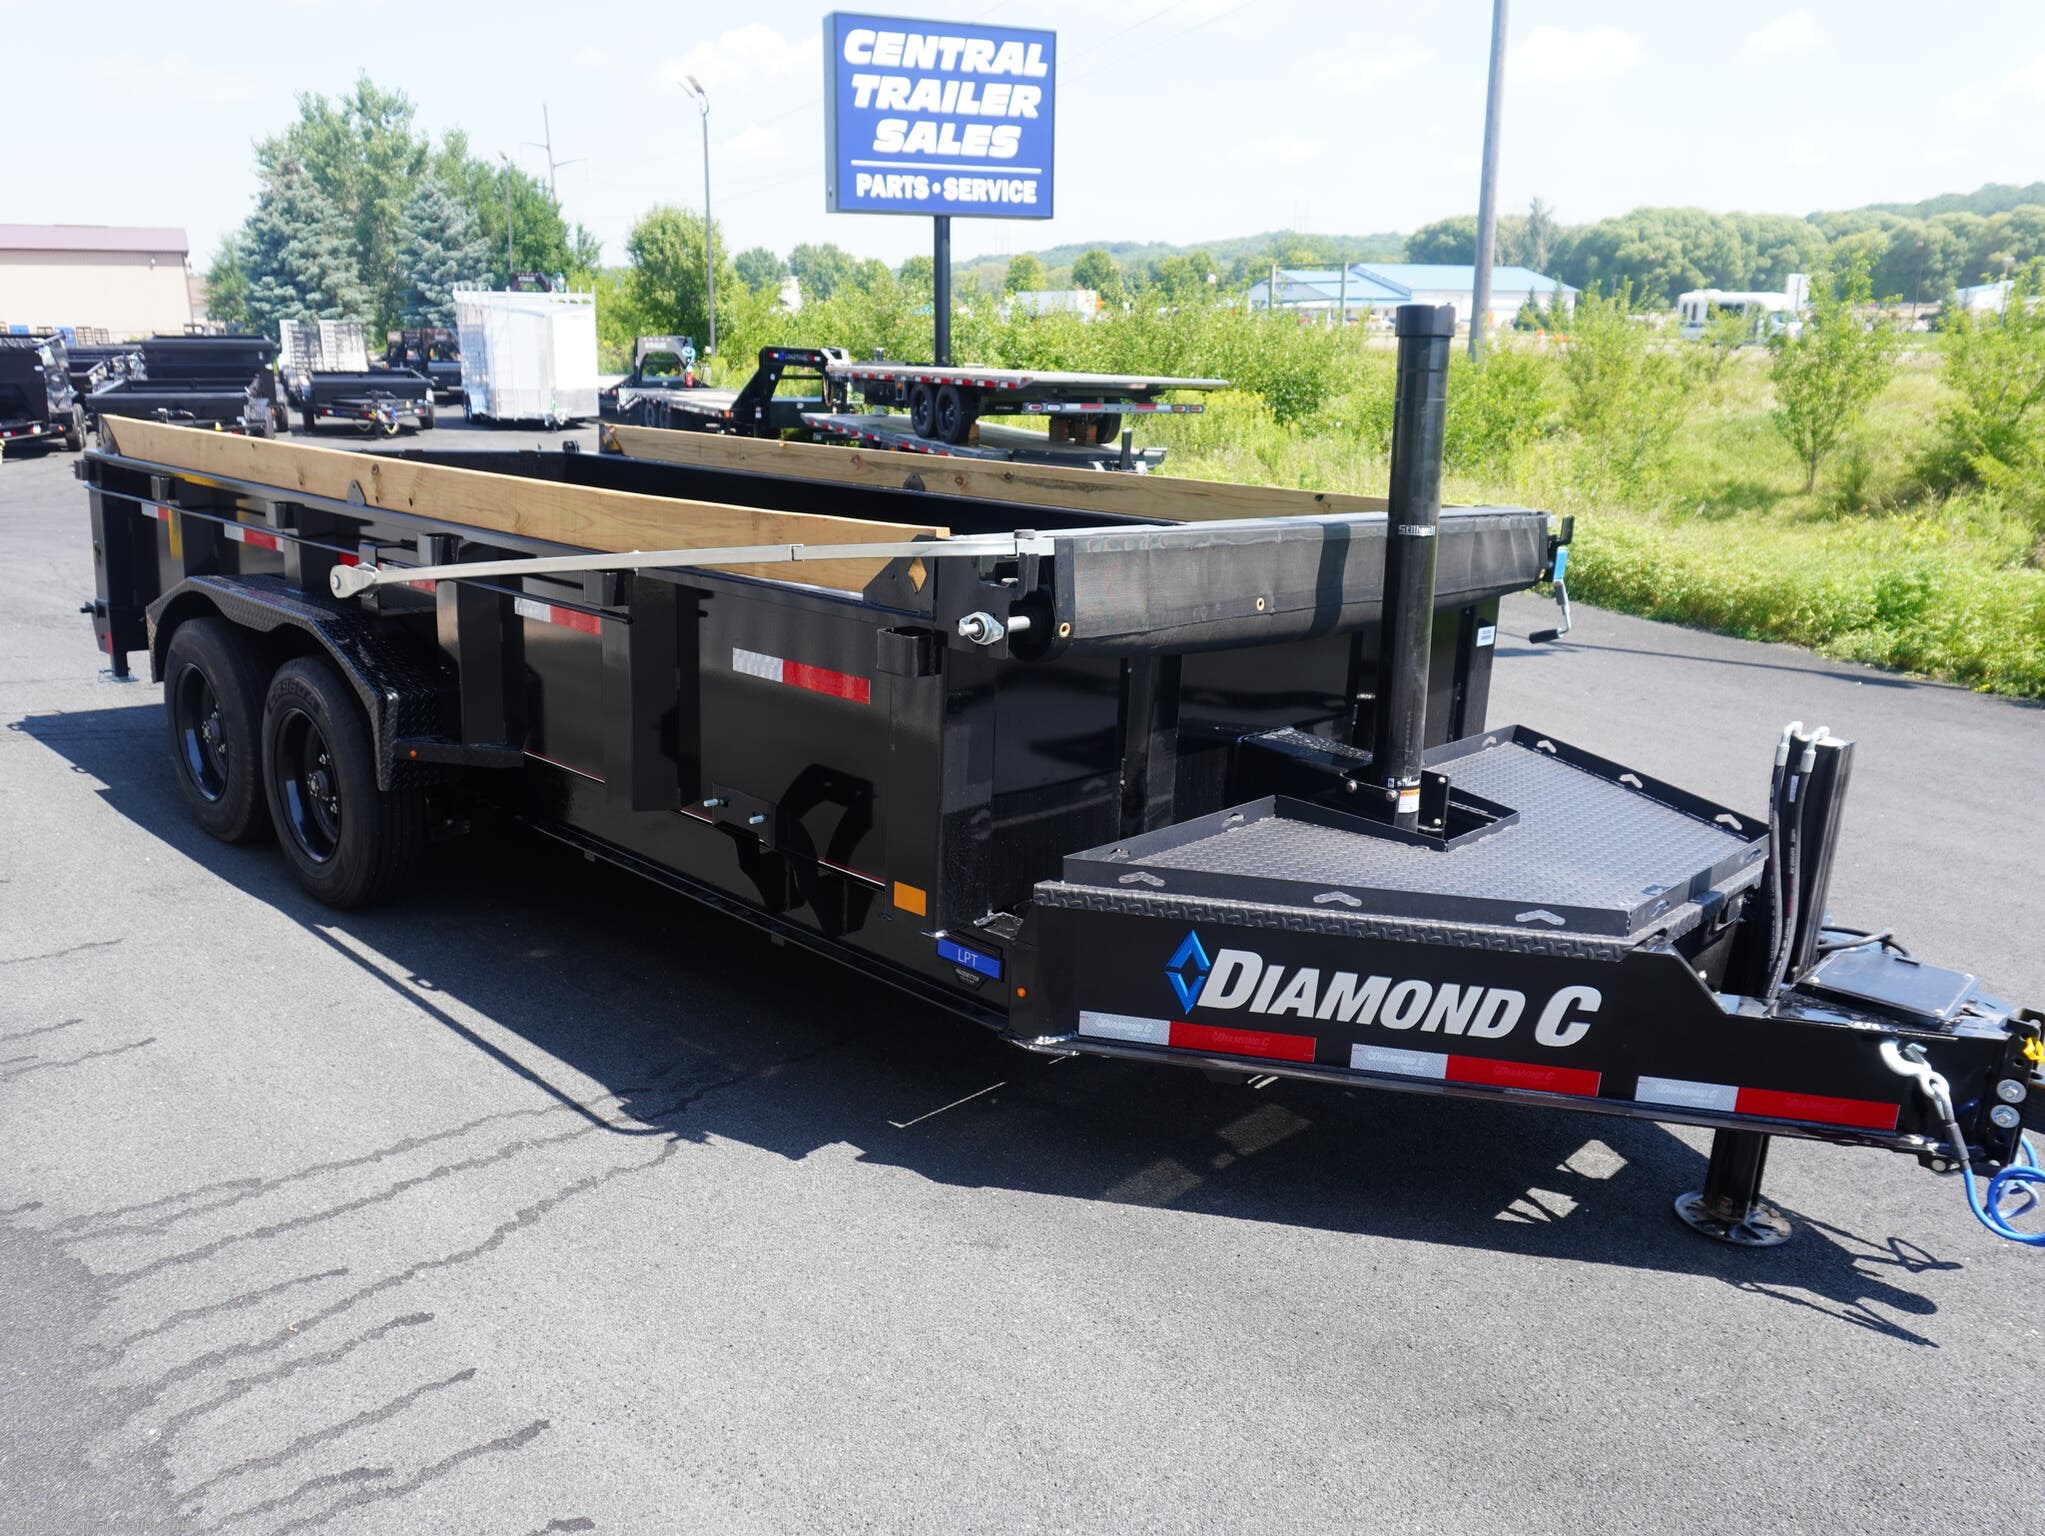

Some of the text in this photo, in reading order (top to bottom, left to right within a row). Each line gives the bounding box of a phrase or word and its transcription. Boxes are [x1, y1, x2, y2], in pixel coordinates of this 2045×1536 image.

[843, 28, 1048, 78] CENTRAL
[851, 74, 1042, 119] TRAILER
[872, 118, 1022, 159] SALES
[856, 173, 1038, 204] PARTS SERVICE
[957, 948, 978, 968] LPT
[1197, 948, 1602, 1048] DIAMOND C
